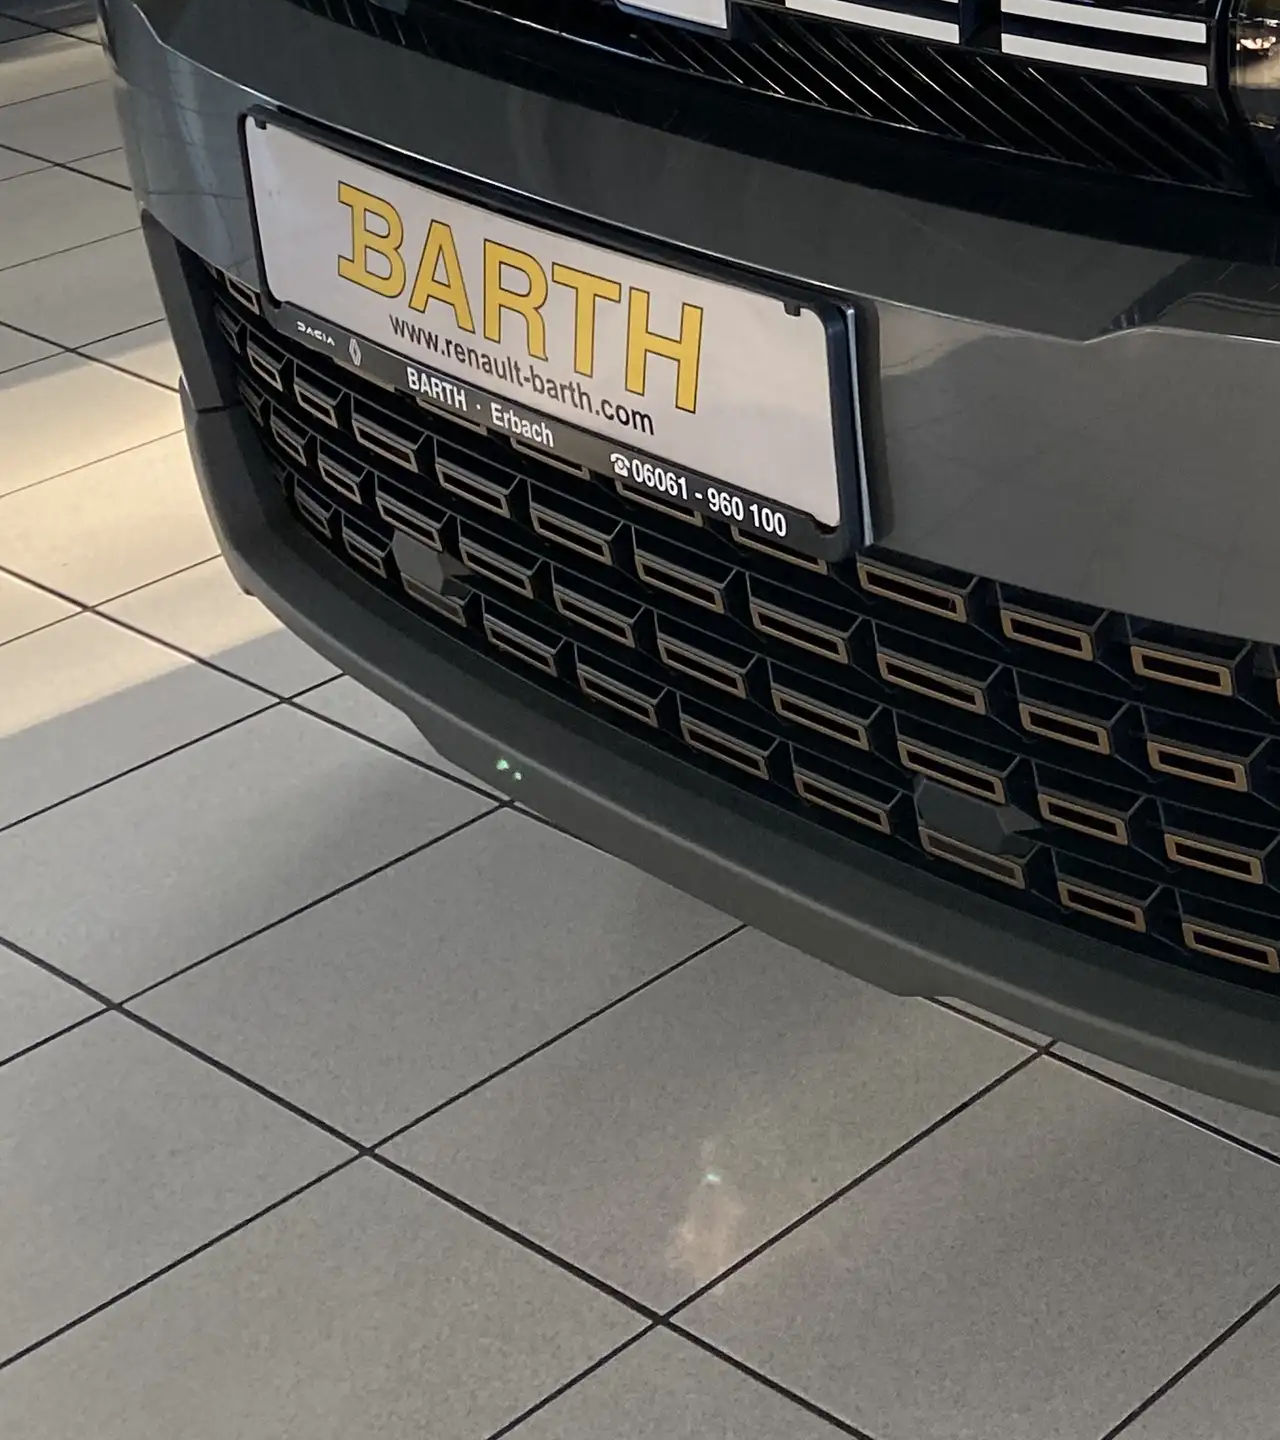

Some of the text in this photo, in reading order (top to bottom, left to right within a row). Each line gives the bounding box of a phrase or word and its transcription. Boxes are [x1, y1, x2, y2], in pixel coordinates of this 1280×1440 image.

[297, 321, 335, 346] DACIA
[338, 180, 703, 413] BARTH
[388, 313, 655, 436] www.renault-barth.com
[406, 366, 467, 411] BARTH
[491, 402, 554, 448] Erbach
[632, 459, 688, 500] 06061
[707, 487, 744, 521] 960
[750, 504, 787, 537] 100
